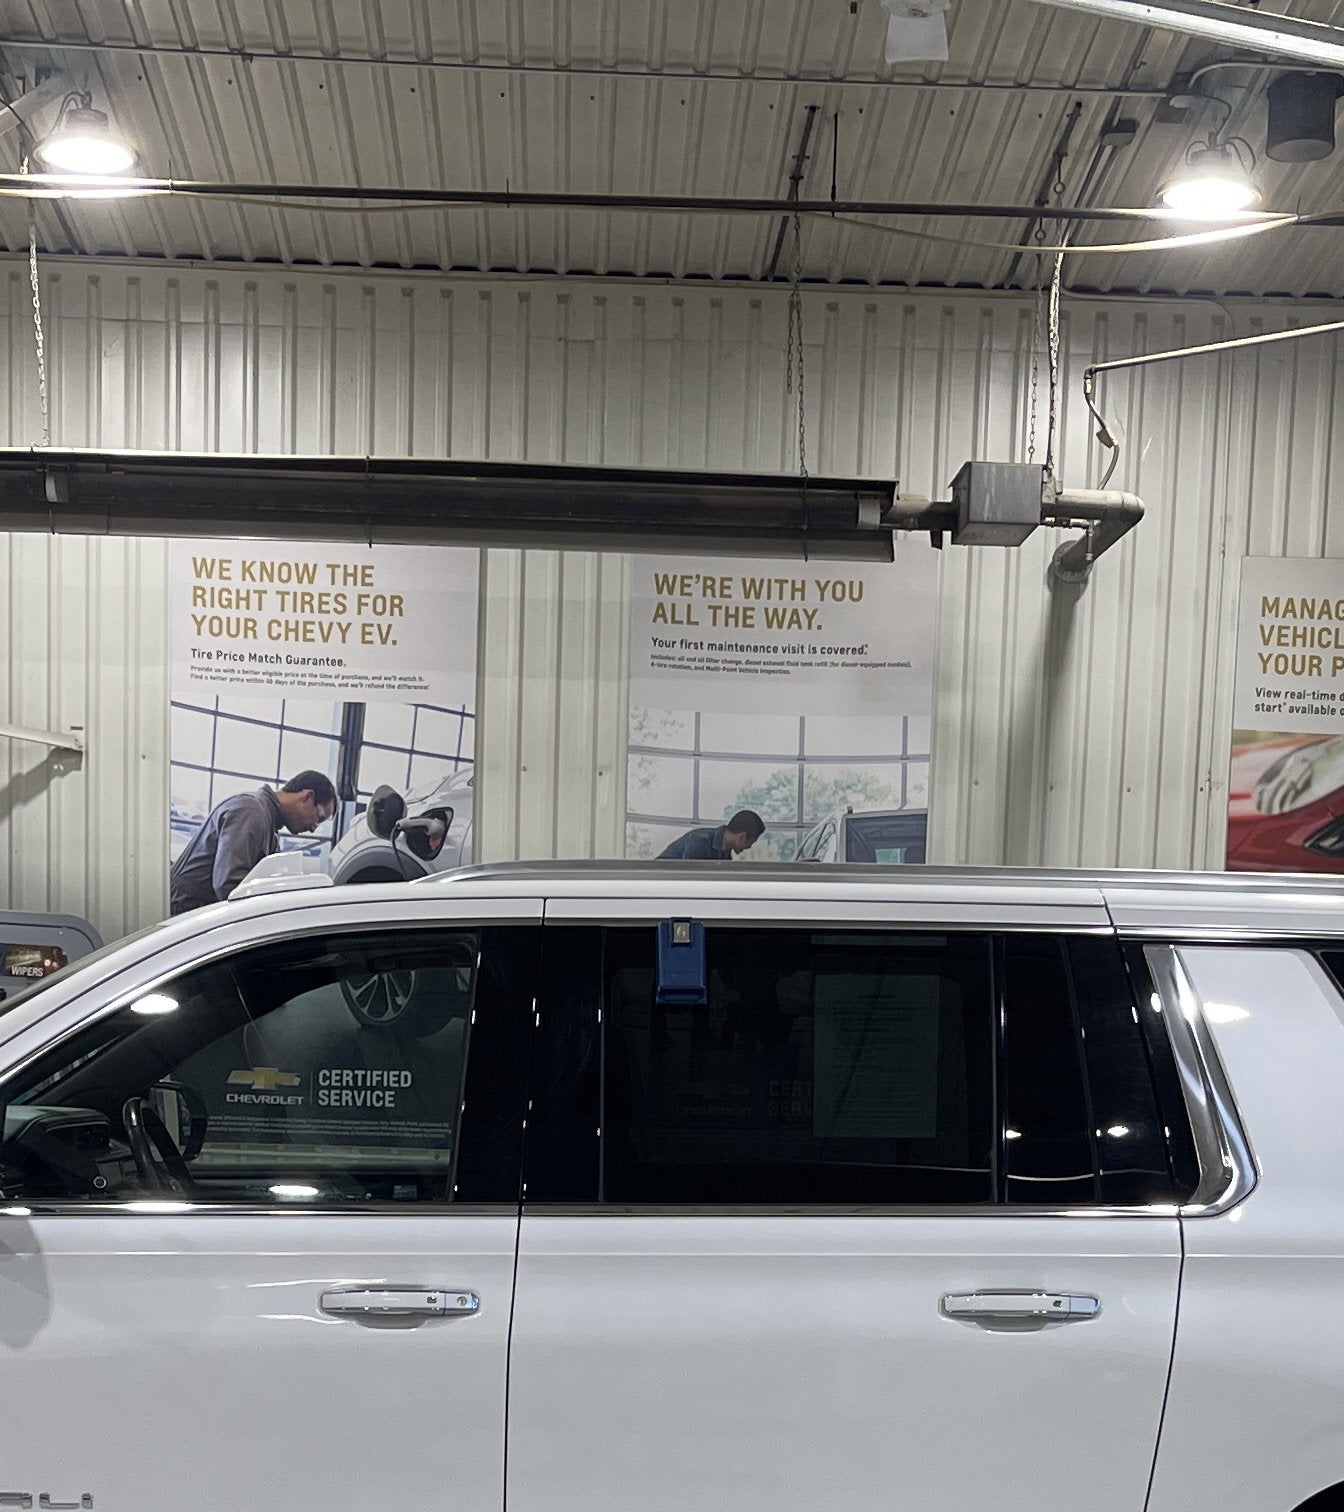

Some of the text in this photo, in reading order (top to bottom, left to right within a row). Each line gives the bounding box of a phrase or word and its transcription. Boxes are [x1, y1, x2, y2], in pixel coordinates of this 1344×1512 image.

[192, 557, 375, 587] WE KNOW THE
[654, 573, 864, 603] WE'RE WITH YOU
[192, 585, 404, 617] RIGHT TIRES FOR
[651, 602, 823, 631] ALL THE WAY.
[191, 614, 398, 646] YOUR CHEVY EV.
[651, 637, 677, 648] Your
[679, 639, 704, 650] first
[707, 640, 779, 654] maintenance
[781, 643, 805, 654] visit
[808, 643, 817, 654] is
[190, 648, 347, 668] Tire Price Match Guarantee.
[1257, 652, 1323, 677] YOUR
[1255, 687, 1282, 699] View
[1284, 689, 1337, 701] real-time
[1288, 703, 1337, 716] available
[11, 966, 44, 977] WIPERS
[318, 1069, 412, 1088] CERTIFIED
[225, 1093, 304, 1105] CHEVROLET
[317, 1089, 395, 1108] SERVICE
